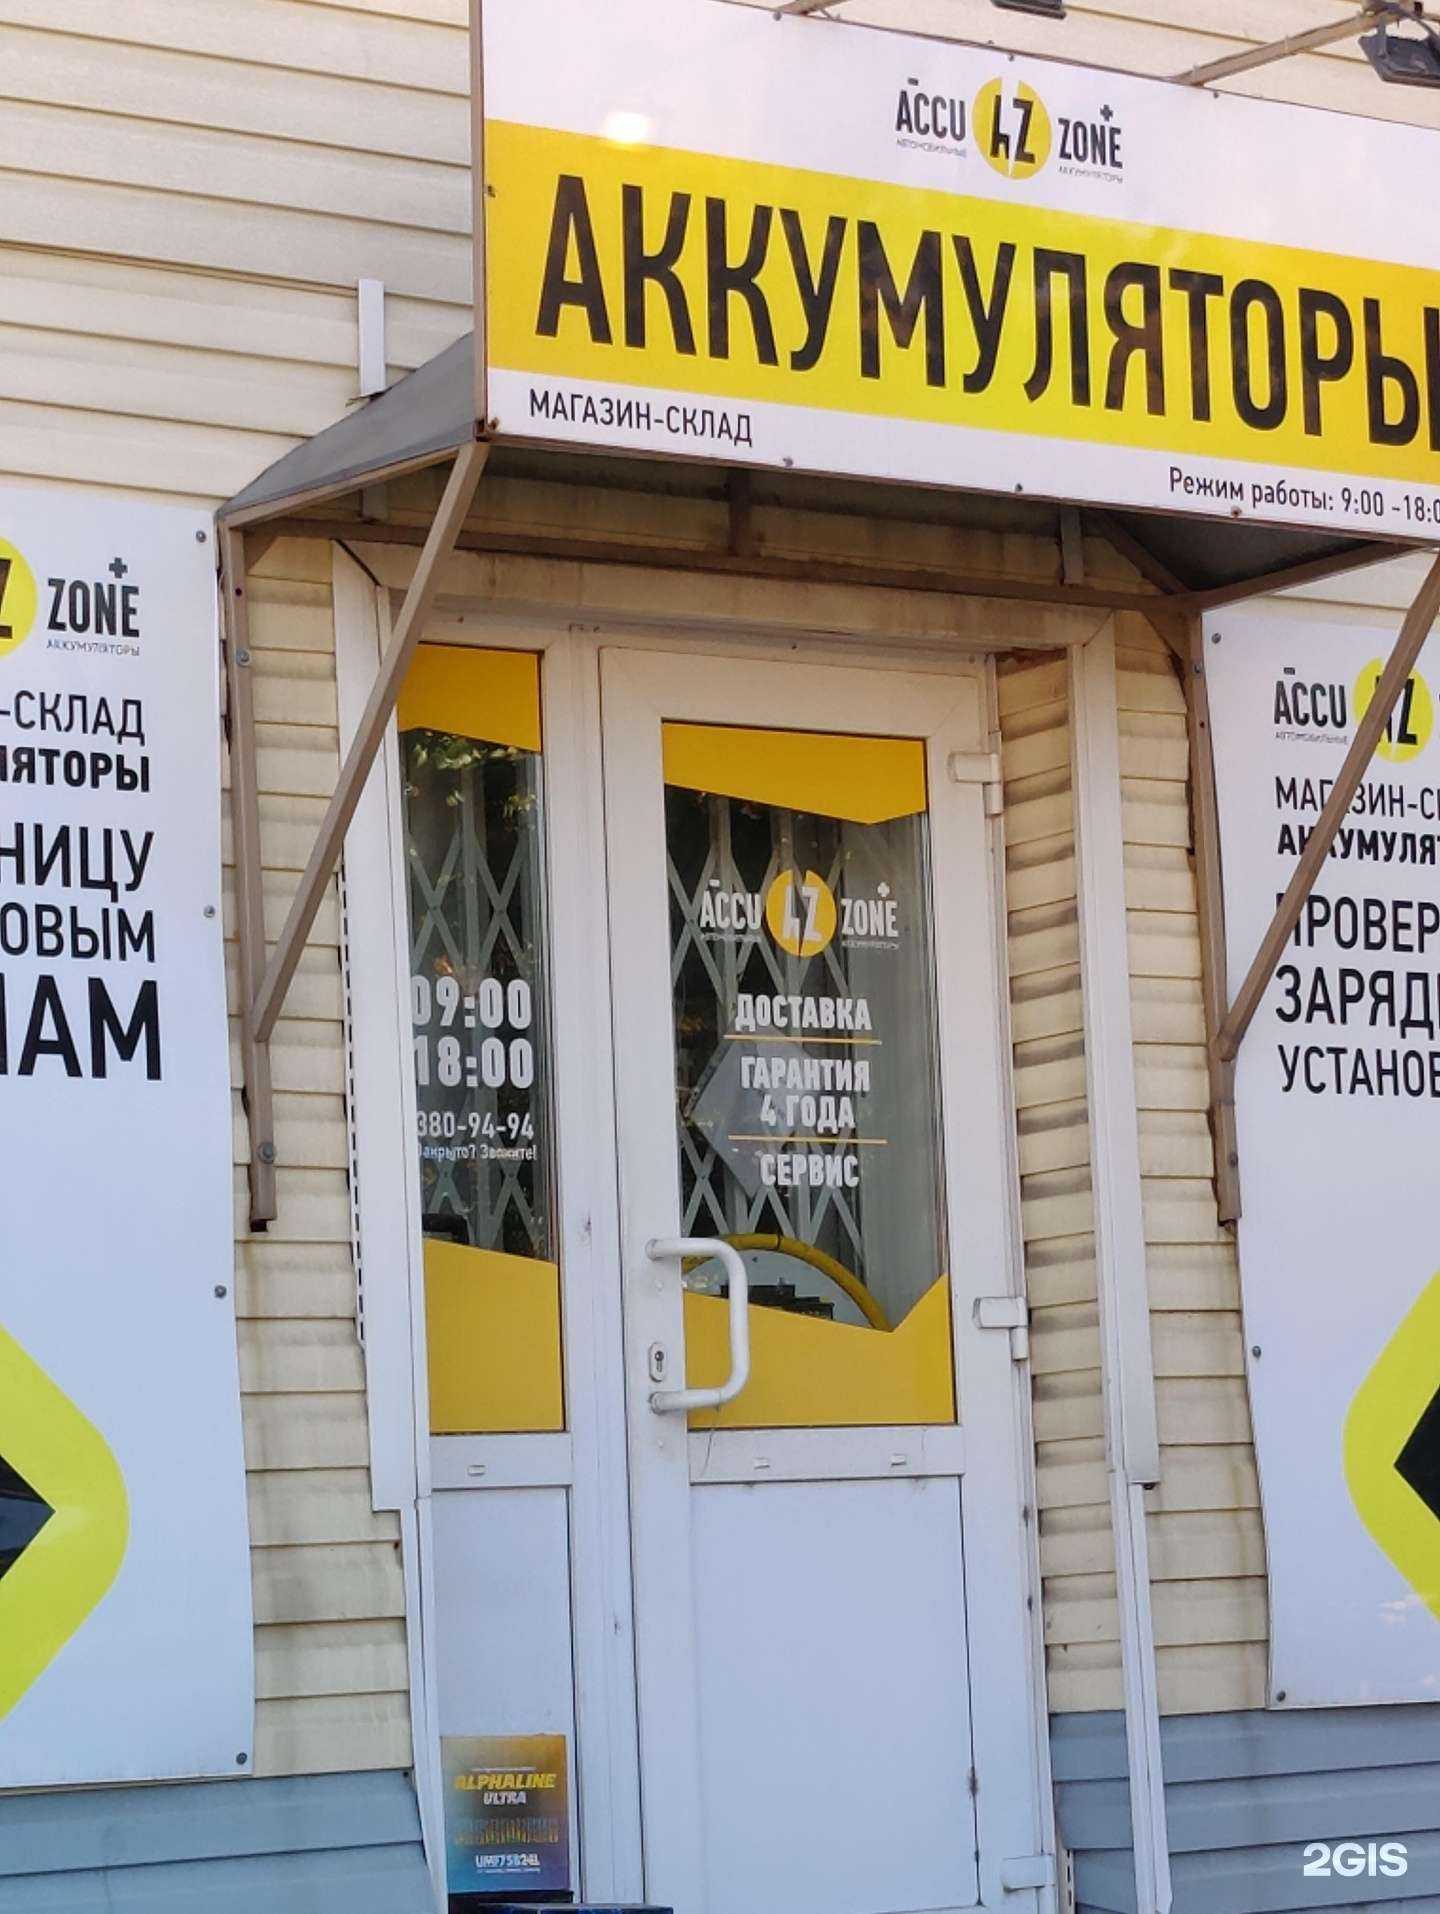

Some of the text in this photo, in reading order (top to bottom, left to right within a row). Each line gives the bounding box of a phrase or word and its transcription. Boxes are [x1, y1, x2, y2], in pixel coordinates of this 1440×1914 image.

[896, 90, 966, 141] ACCU
[1058, 117, 1123, 169] ZONE
[535, 174, 1440, 452] АККУМУЛЯТОРЫ
[529, 388, 753, 447] МАГАЗИН-СКЛАД
[1169, 466, 1245, 500] Режим
[1252, 479, 1334, 510] работы:
[1342, 487, 1384, 516] 9:00
[47, 577, 140, 638] ZONE
[1274, 680, 1348, 728] ACCU
[1275, 776, 1440, 822] МАГЗИН-С
[0, 822, 155, 903] НИЦУ
[0, 902, 155, 962] ОВЫМ
[700, 890, 762, 930] ACCU
[841, 898, 899, 937] ZONE
[0, 972, 162, 1081] АМ
[411, 975, 532, 1029] 09:00
[735, 994, 872, 1031] ДОСТАВКА
[1275, 964, 1440, 1041] ЗАРЯД
[414, 1035, 534, 1089] 18:00
[740, 1056, 870, 1092] ГАРАНТИЯ
[760, 1094, 856, 1134] 4 ГОДА
[760, 1153, 859, 1187] СЕРВИС
[456, 1773, 557, 1790] ALPHALINE
[483, 1791, 527, 1805] ULTRA
